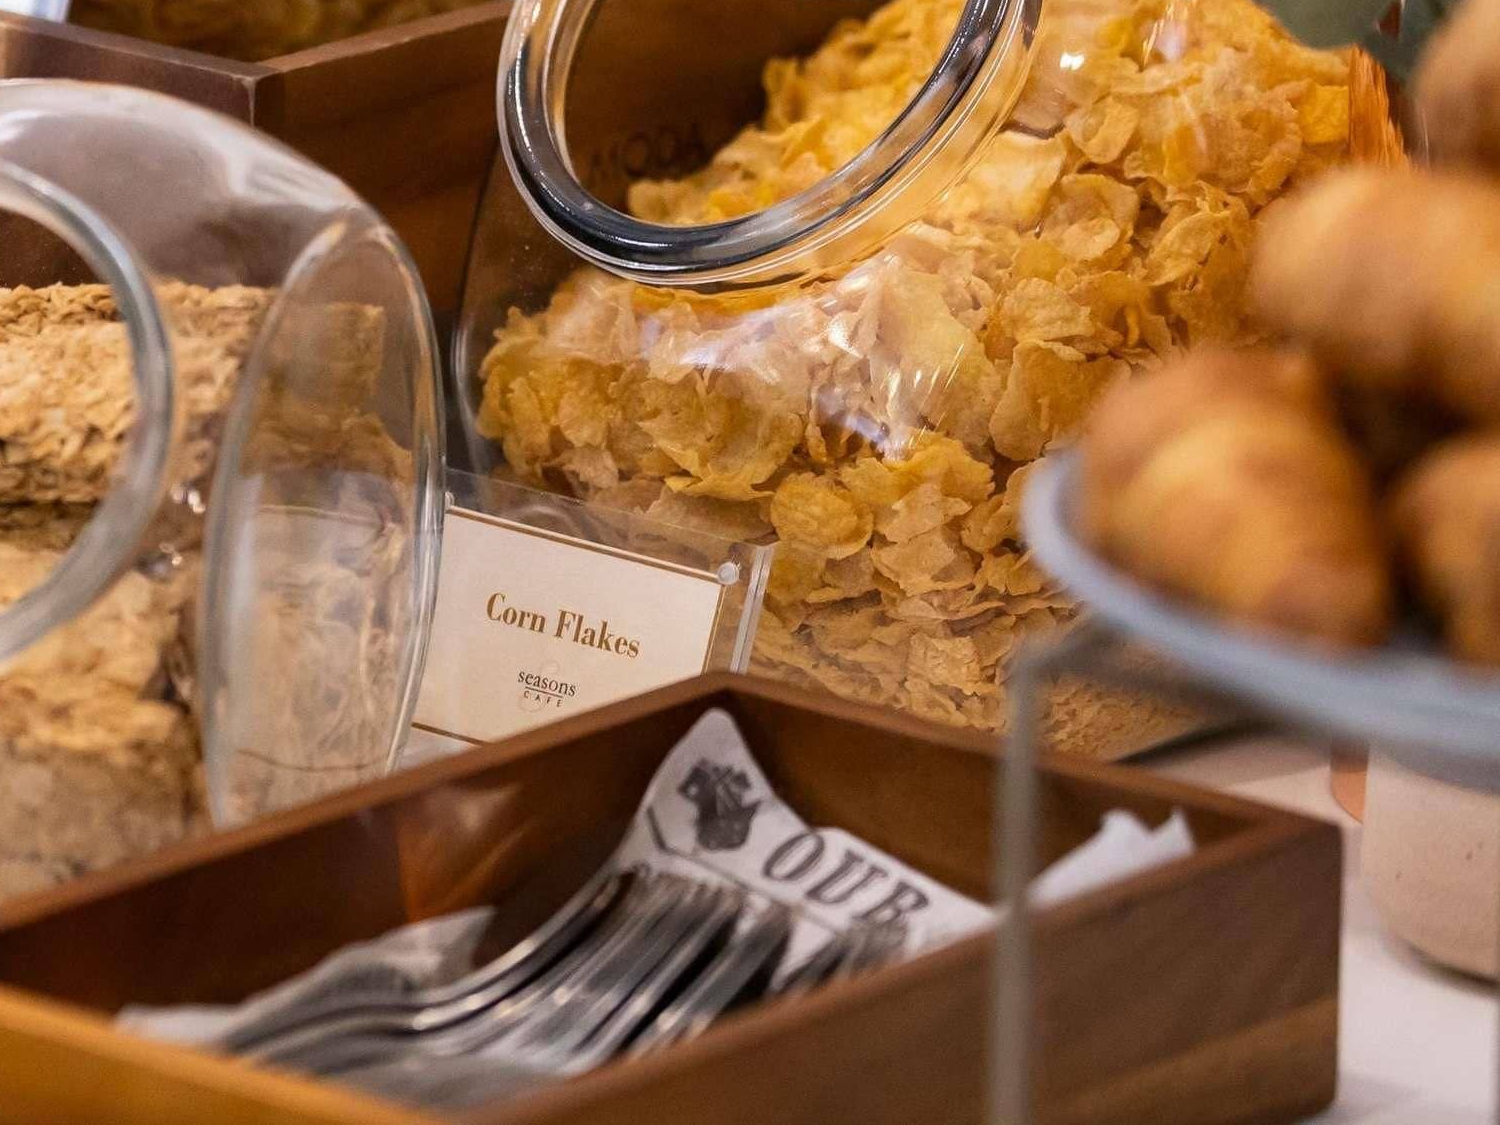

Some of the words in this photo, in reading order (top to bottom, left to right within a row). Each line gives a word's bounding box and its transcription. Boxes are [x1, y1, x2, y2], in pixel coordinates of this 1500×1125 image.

[486, 593, 546, 633] Corn
[553, 609, 641, 659] Flakes
[517, 670, 578, 698] seasons
[523, 690, 563, 708] CAFE
